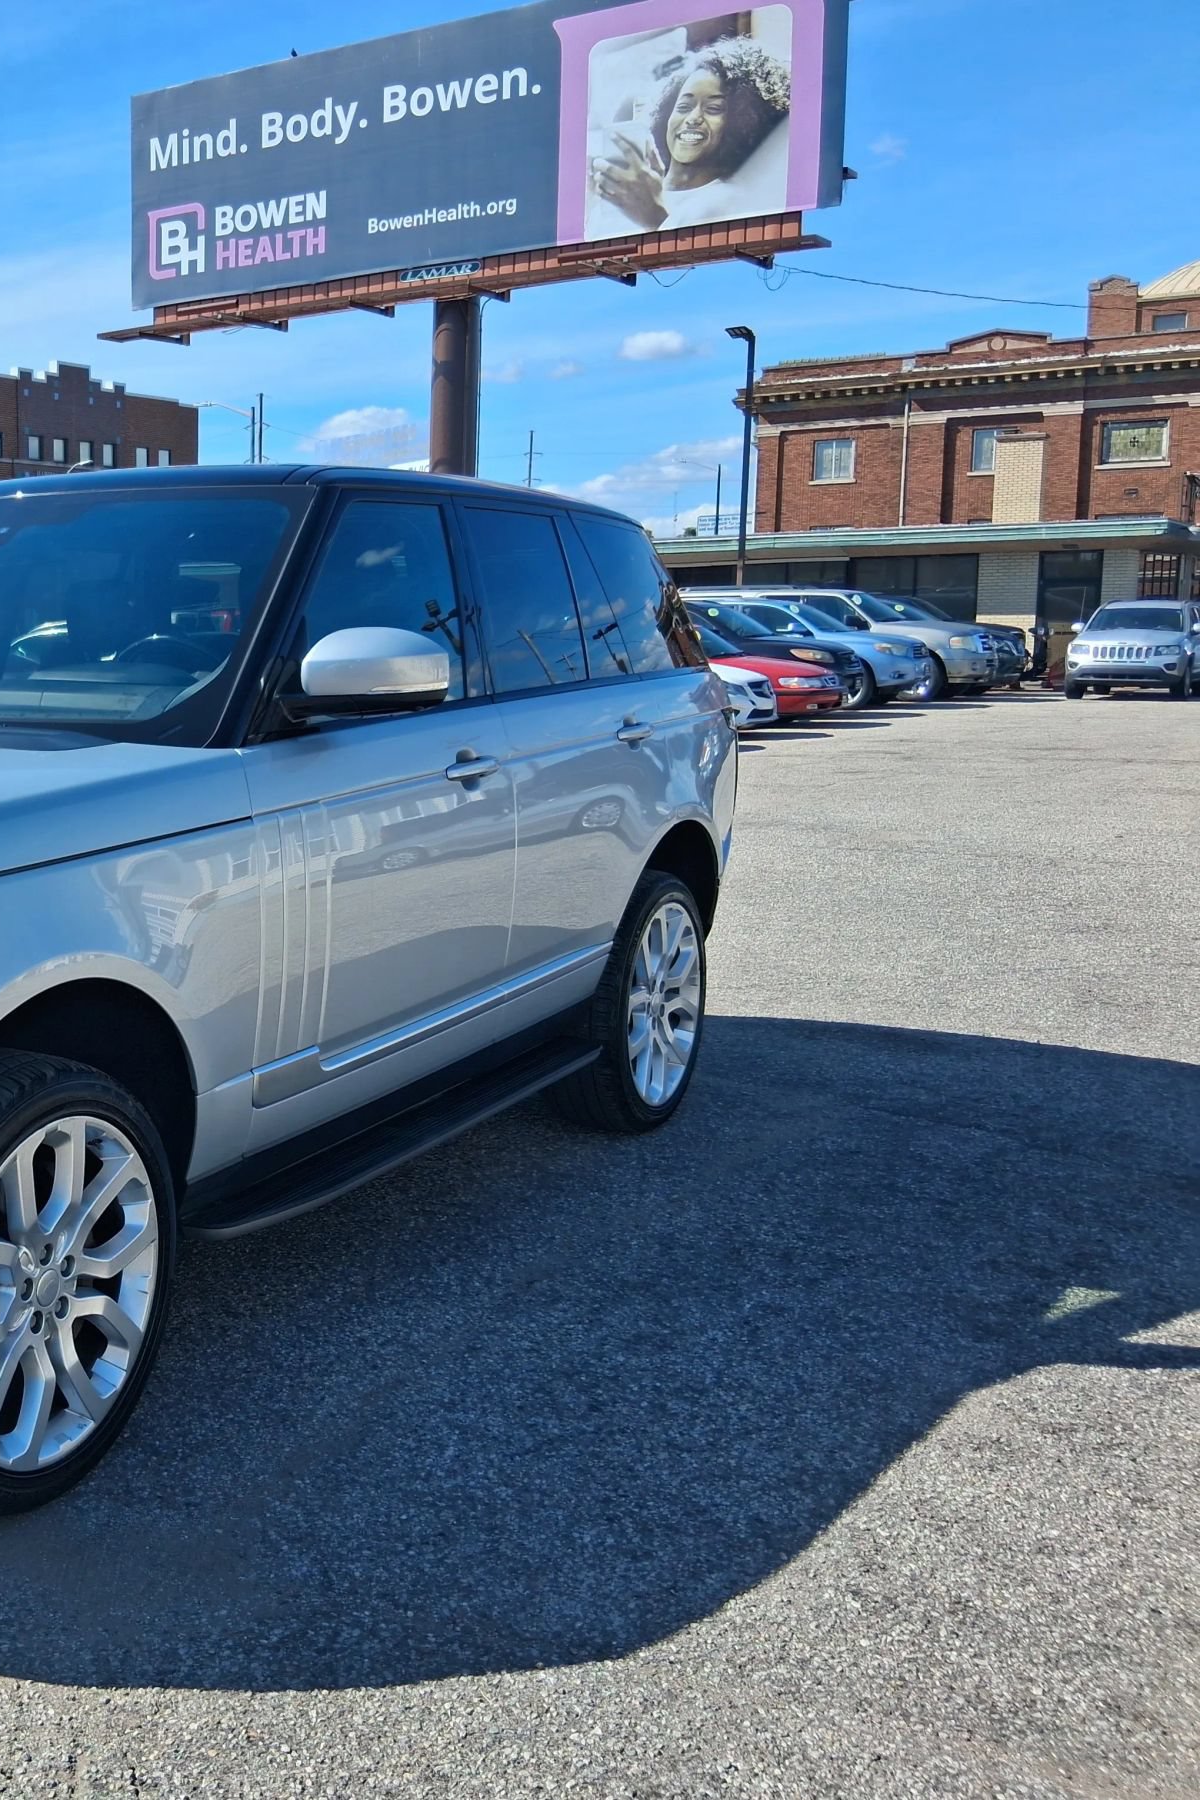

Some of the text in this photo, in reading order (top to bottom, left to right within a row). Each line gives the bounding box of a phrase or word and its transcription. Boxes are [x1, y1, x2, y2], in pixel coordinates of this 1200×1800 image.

[149, 66, 542, 172] Mind. Body. Bowen.
[214, 190, 327, 237] BOWEN
[367, 198, 517, 234] BowenHealth.org
[215, 226, 326, 271] HEALTH
[406, 263, 473, 281] LAMAR
